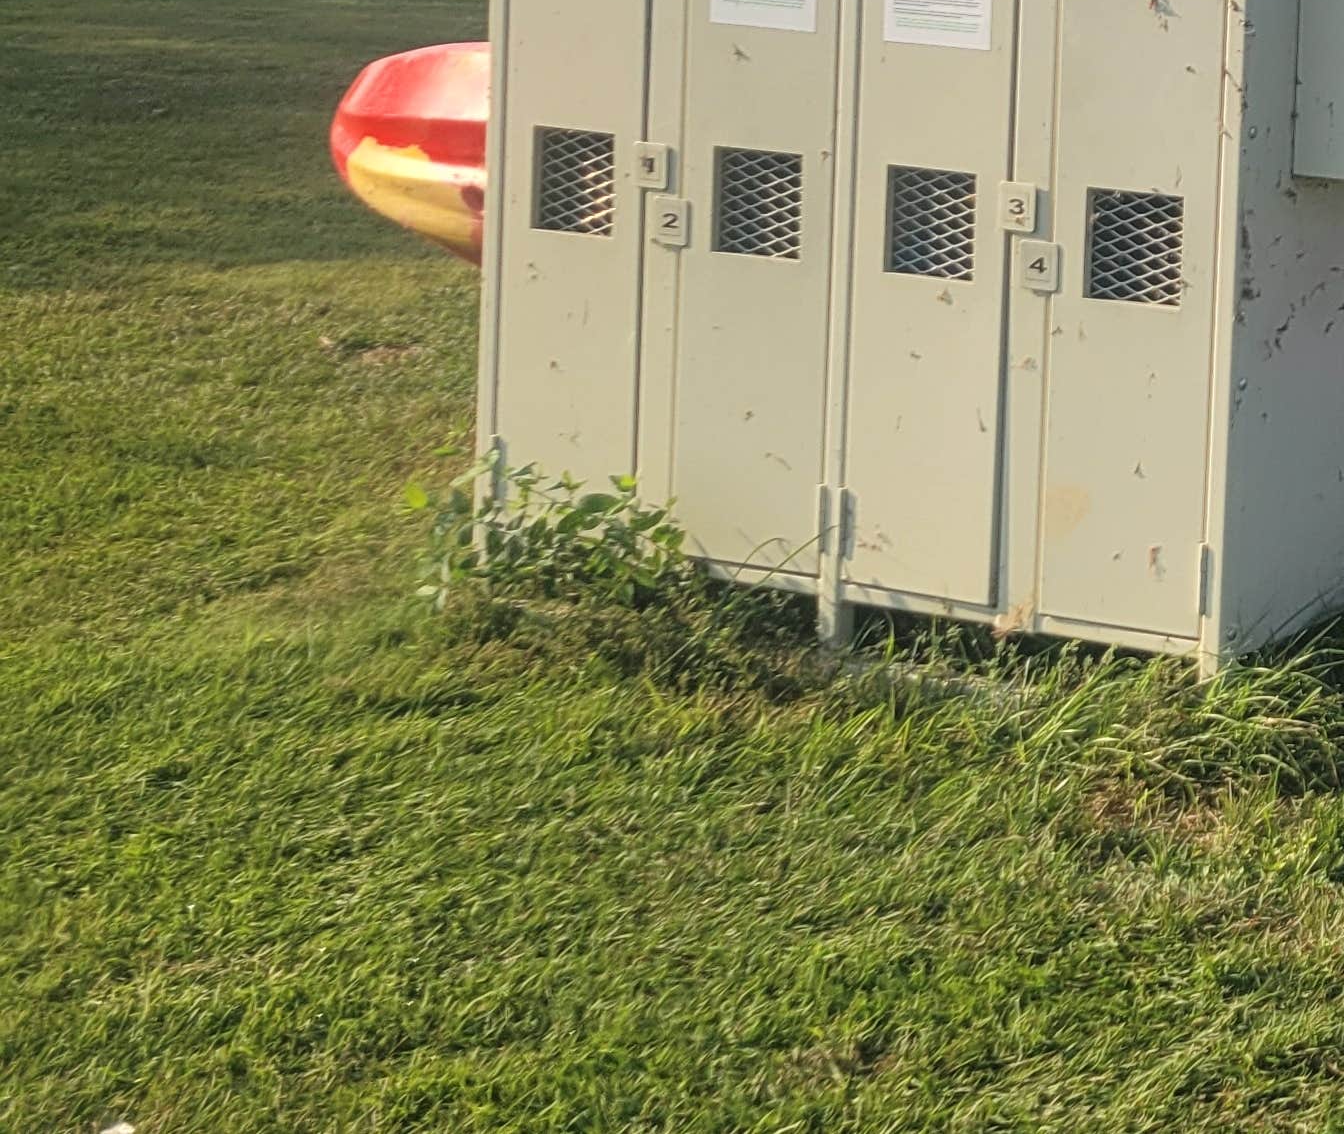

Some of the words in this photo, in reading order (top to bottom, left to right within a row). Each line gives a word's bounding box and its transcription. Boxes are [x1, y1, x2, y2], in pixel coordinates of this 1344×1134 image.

[1008, 198, 1025, 215] 3
[661, 213, 680, 229] 2
[1029, 257, 1048, 274] 4
